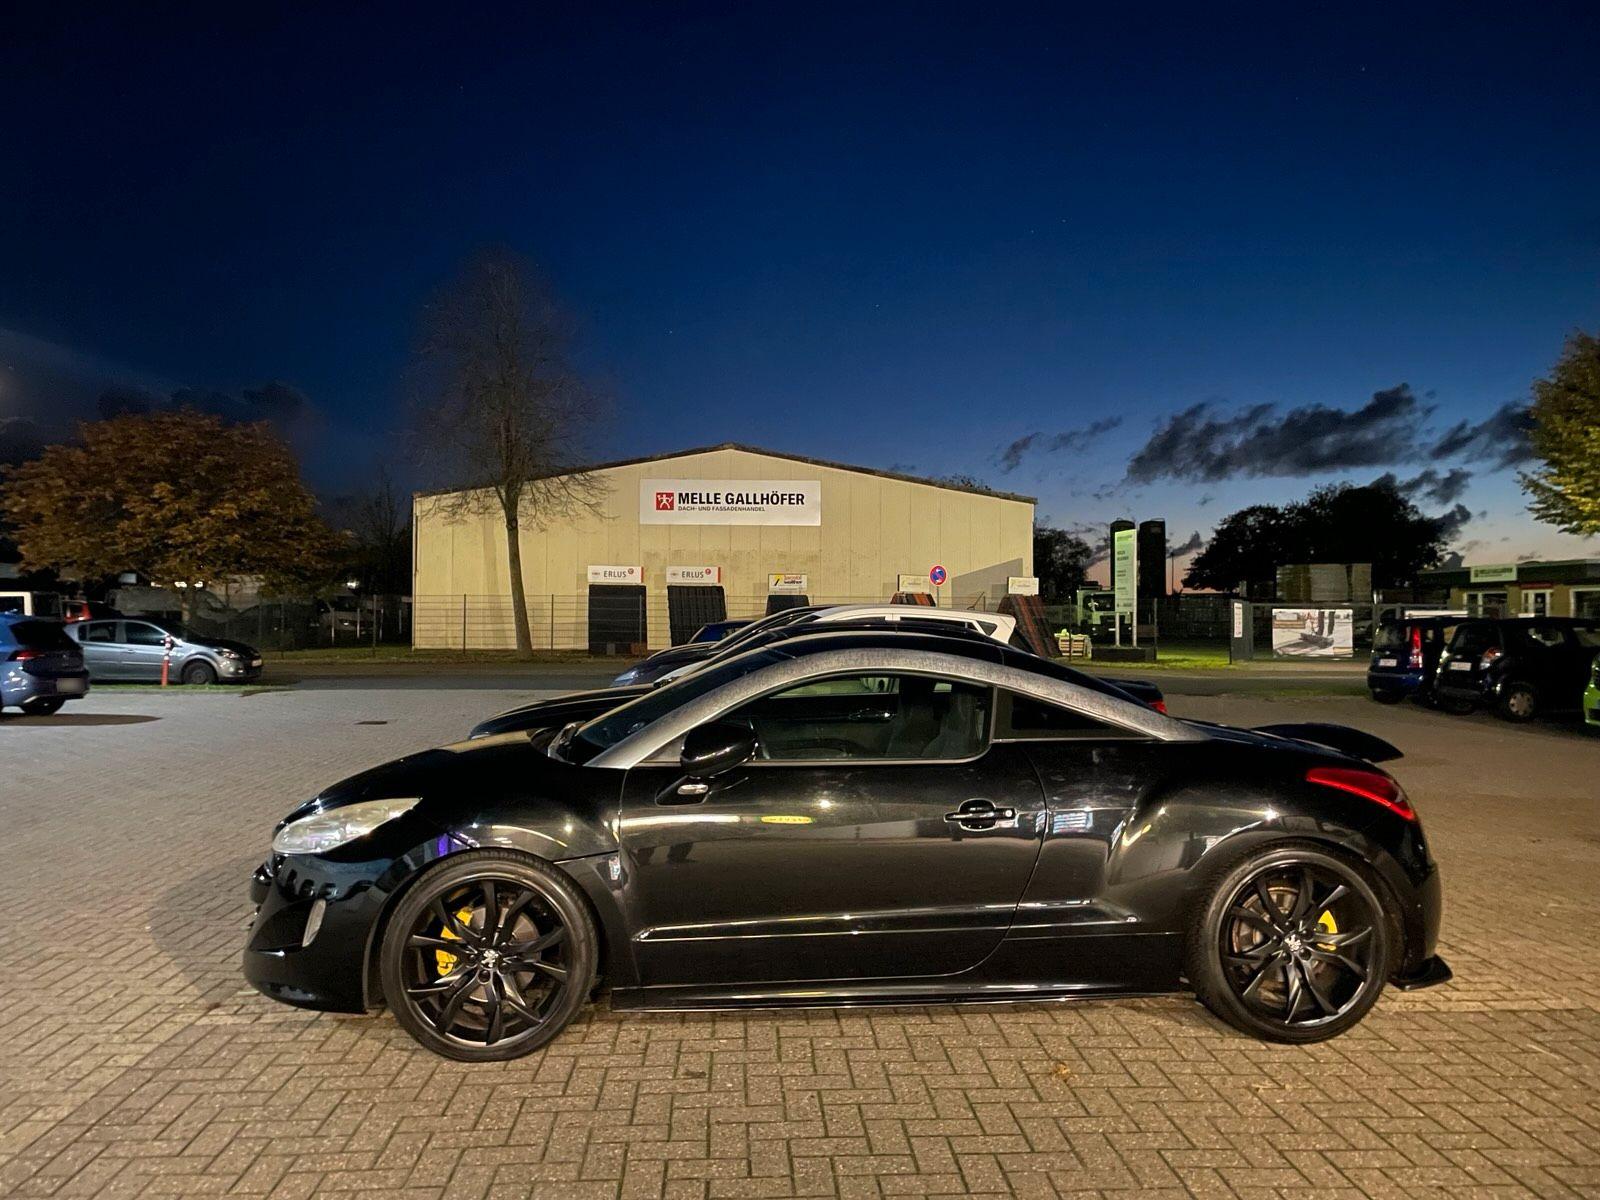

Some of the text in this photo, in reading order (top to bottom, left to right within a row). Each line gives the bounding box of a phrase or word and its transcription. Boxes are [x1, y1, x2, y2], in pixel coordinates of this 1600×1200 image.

[678, 491, 805, 505] MELLE GALLHÖFER
[603, 570, 627, 578] ERLUS
[681, 571, 704, 579] ERLUS
